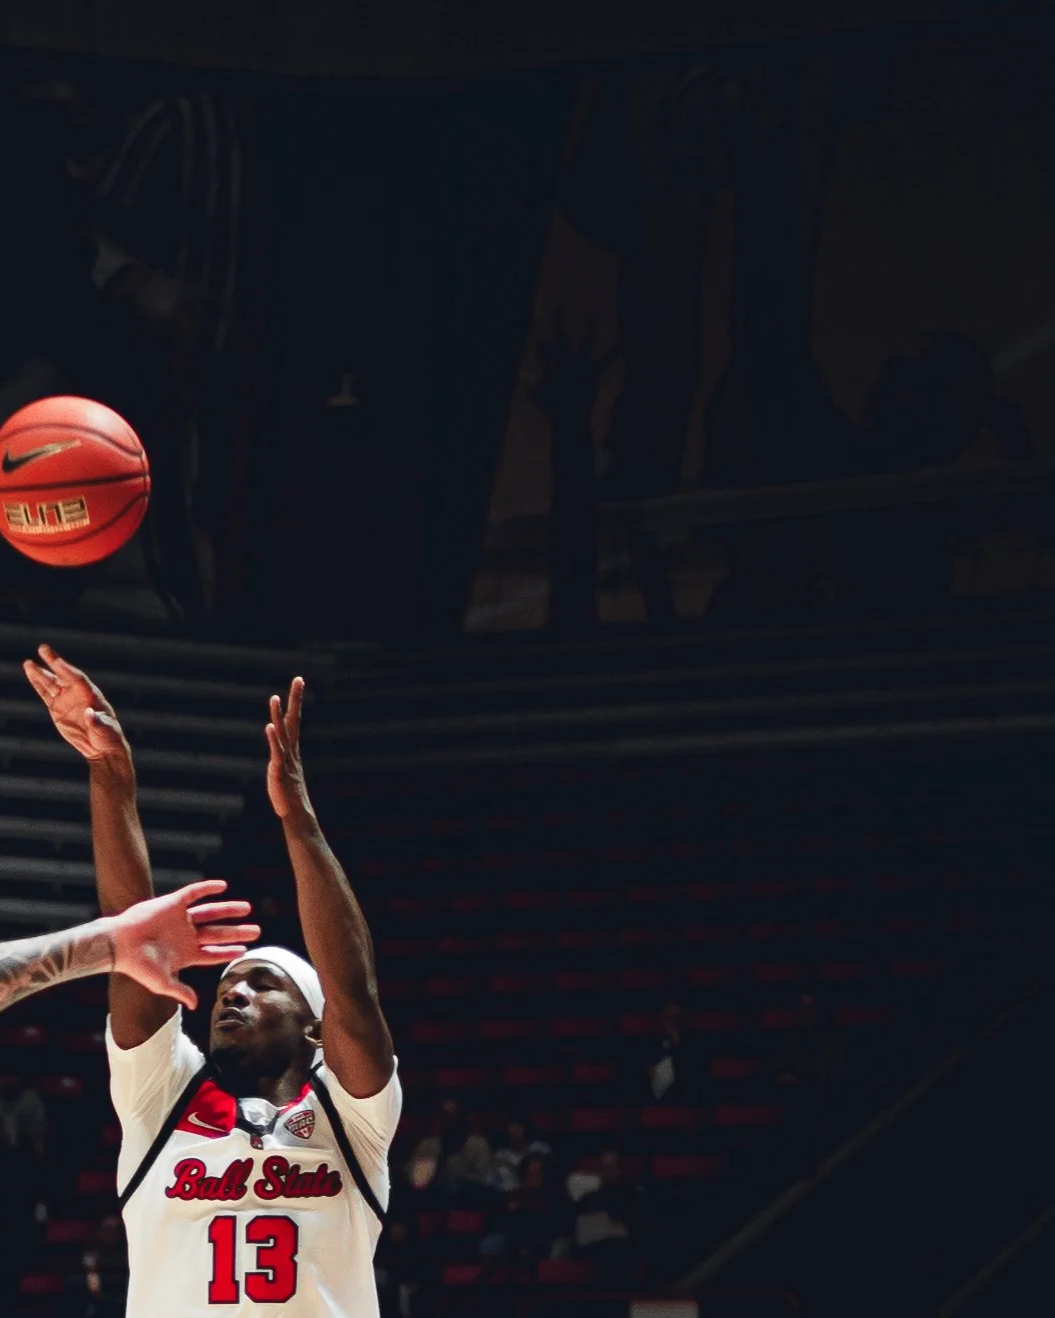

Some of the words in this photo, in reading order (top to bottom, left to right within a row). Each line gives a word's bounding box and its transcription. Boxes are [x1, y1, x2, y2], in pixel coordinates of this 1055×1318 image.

[3, 496, 90, 534] ELITE
[165, 1157, 254, 1201] Ball
[254, 1155, 343, 1200] State
[208, 1215, 299, 1304] 13
